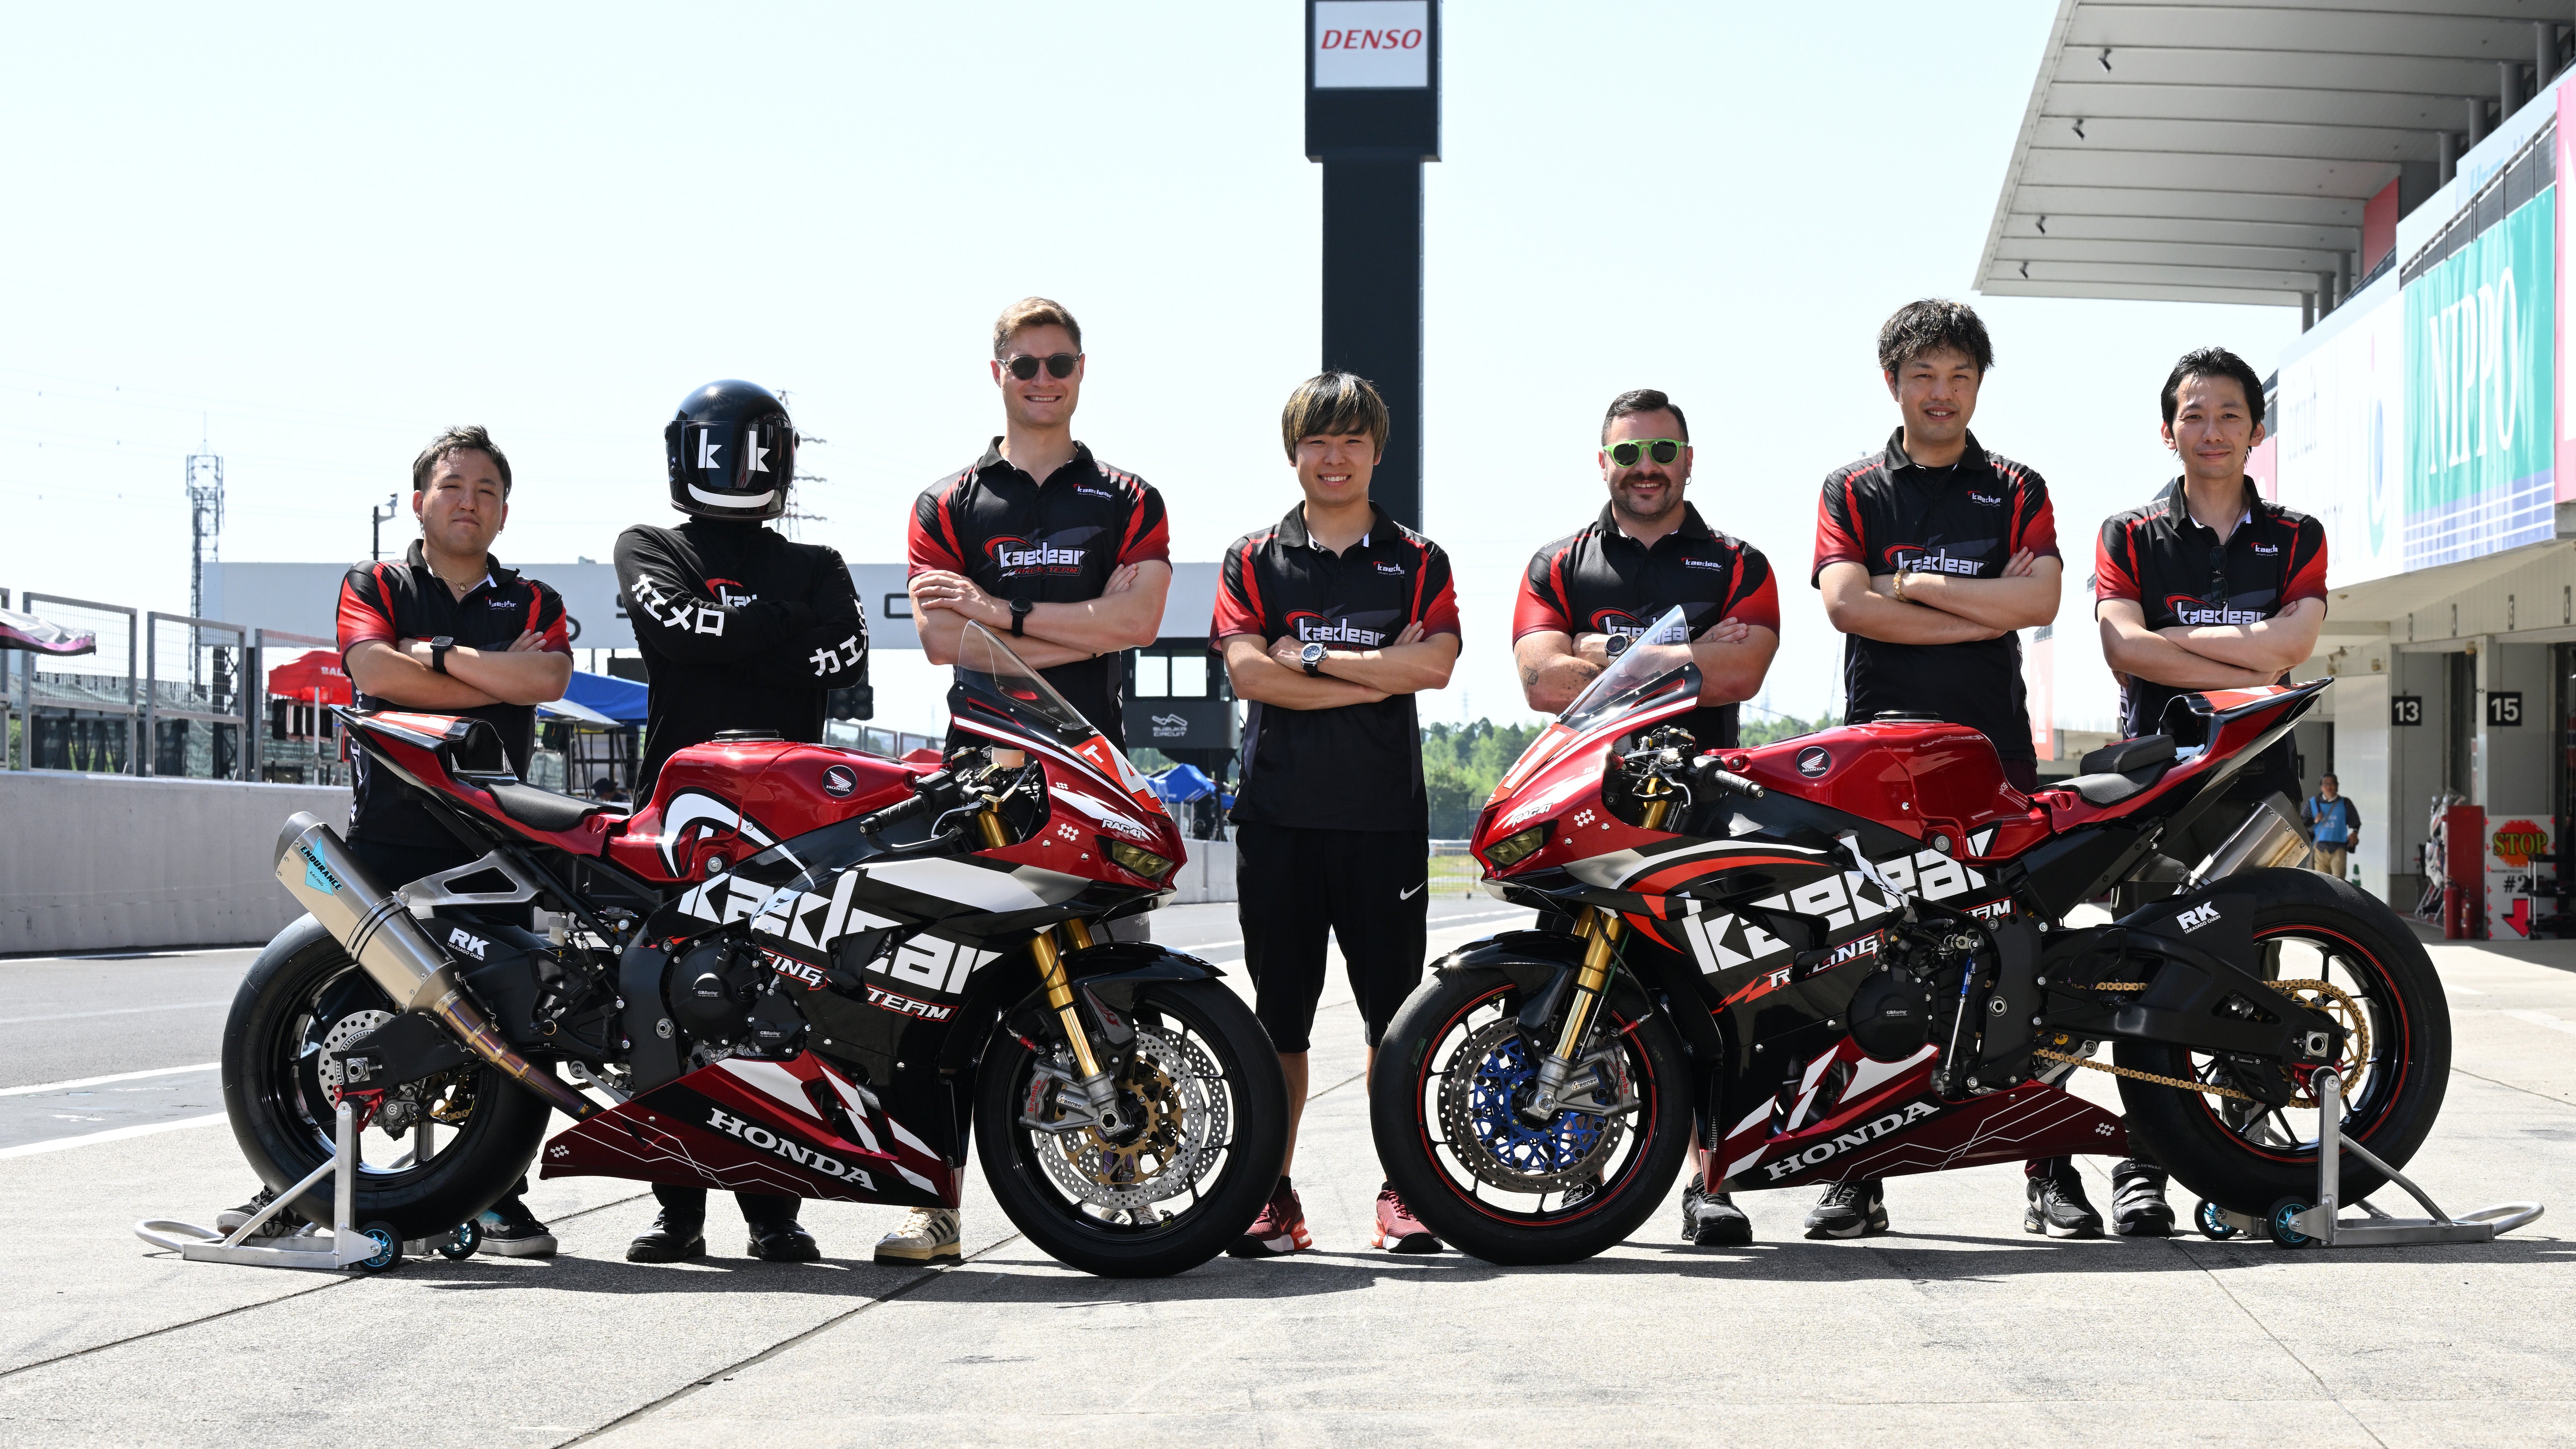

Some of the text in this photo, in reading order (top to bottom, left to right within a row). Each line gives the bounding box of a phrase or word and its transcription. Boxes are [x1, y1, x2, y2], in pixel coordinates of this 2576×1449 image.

[1321, 29, 1422, 50] DENSO
[2429, 266, 2518, 475] NIPPO
[2256, 544, 2278, 553] kaede
[632, 574, 724, 637] カエメロ
[2395, 701, 2419, 722] 13
[2491, 697, 2519, 722] 15
[2493, 833, 2548, 856] STOP
[300, 846, 343, 891] ENDURANCE
[309, 871, 324, 886] RACING
[2176, 901, 2220, 930] RK
[2184, 914, 2221, 935] TAKASAGO CHAIN
[447, 942, 484, 961] TAKASAGO CHAIN
[449, 927, 491, 957] RK
[866, 986, 952, 1022] TEAM
[1028, 1080, 1041, 1112] brembo
[706, 1107, 878, 1192] HONDA
[1763, 1101, 1940, 1182] HONDA
